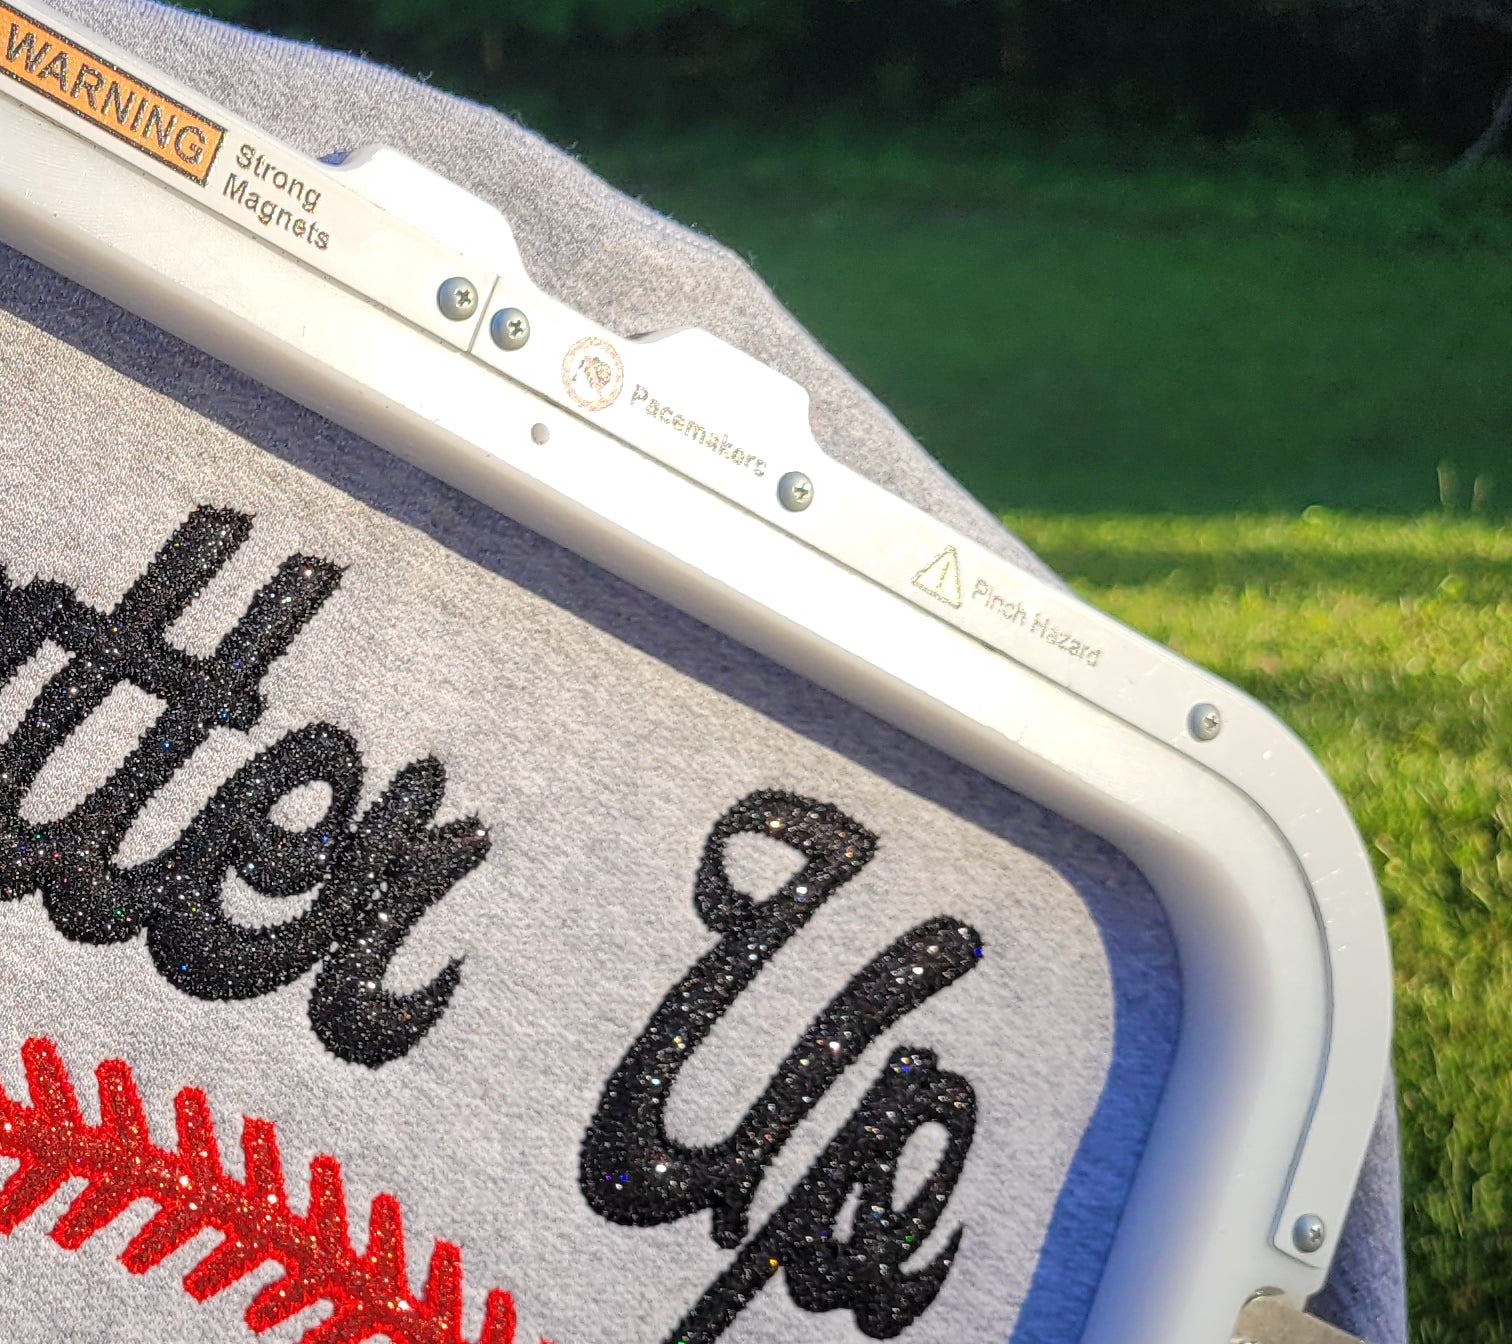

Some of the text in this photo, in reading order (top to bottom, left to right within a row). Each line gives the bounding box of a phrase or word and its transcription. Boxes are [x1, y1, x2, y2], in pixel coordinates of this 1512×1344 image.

[6, 23, 207, 166] WARNING
[222, 172, 331, 251] Magnets
[235, 144, 322, 213] Strong
[630, 385, 768, 478] Pacemakers
[972, 577, 1102, 669] Pinch Hazard
